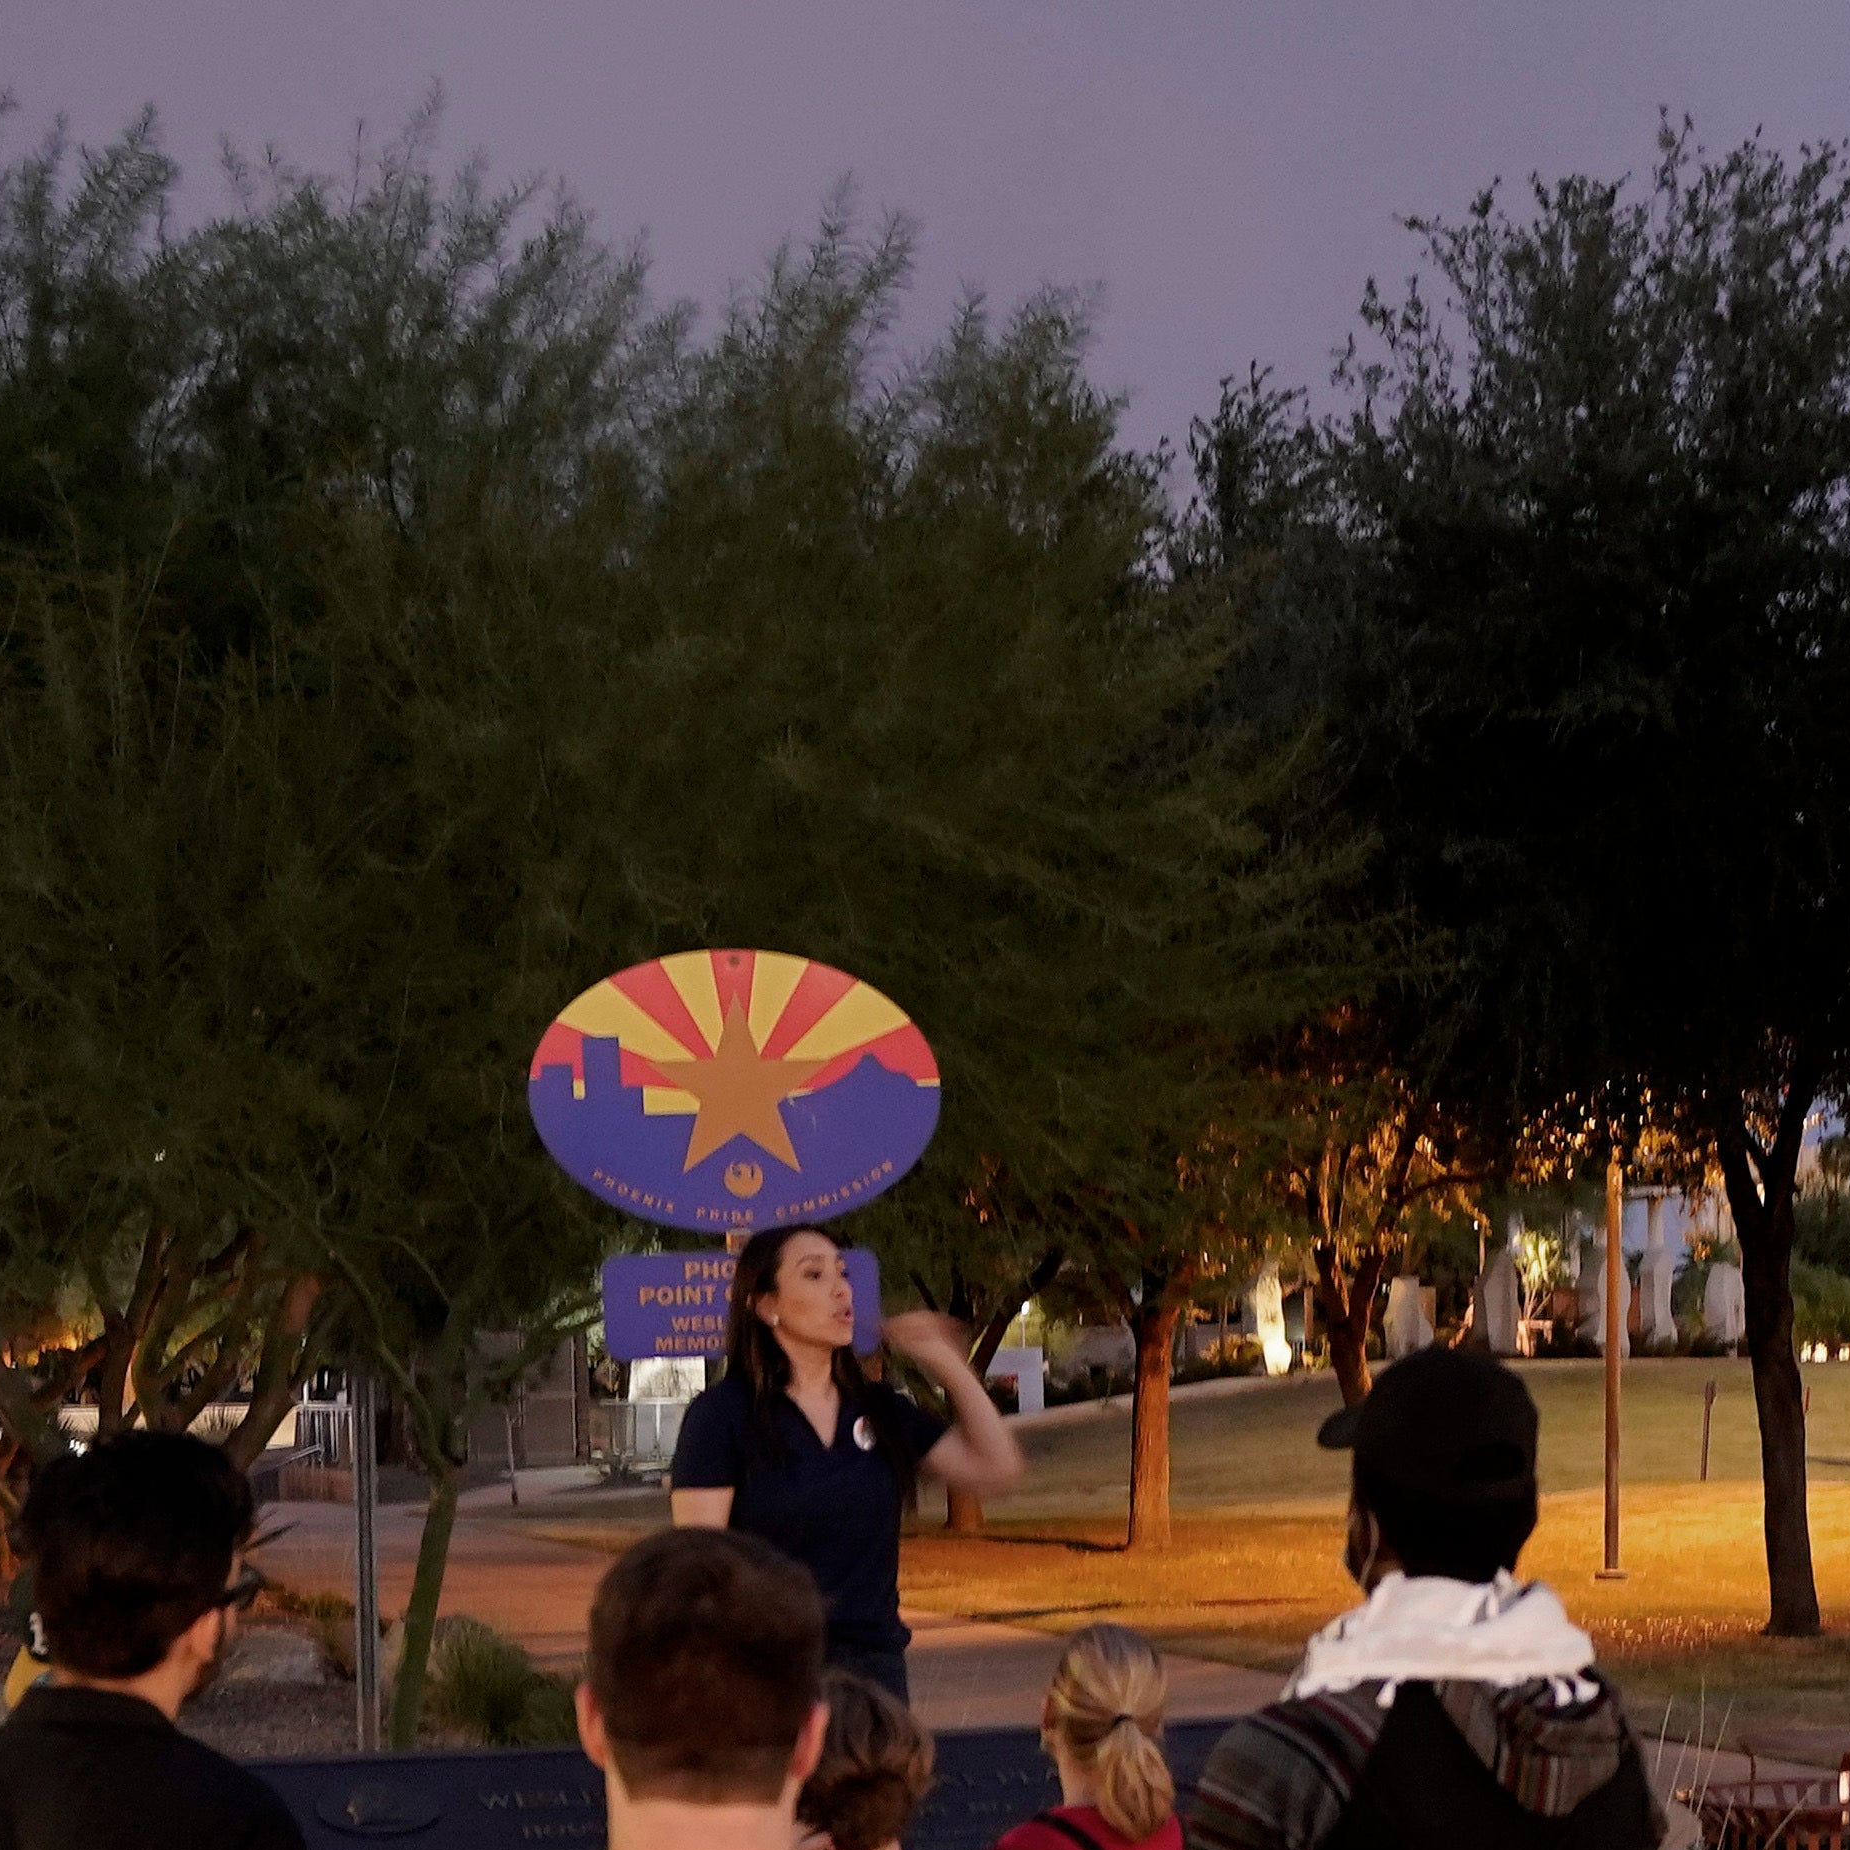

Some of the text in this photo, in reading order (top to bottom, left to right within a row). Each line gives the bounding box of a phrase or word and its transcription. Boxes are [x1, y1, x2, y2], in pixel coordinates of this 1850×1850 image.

[592, 1159, 894, 1225] PHOENIX PRIDE COMMISSION
[683, 1260, 738, 1282] PHO
[638, 1284, 718, 1306] POINT
[671, 1314, 726, 1333] WESL
